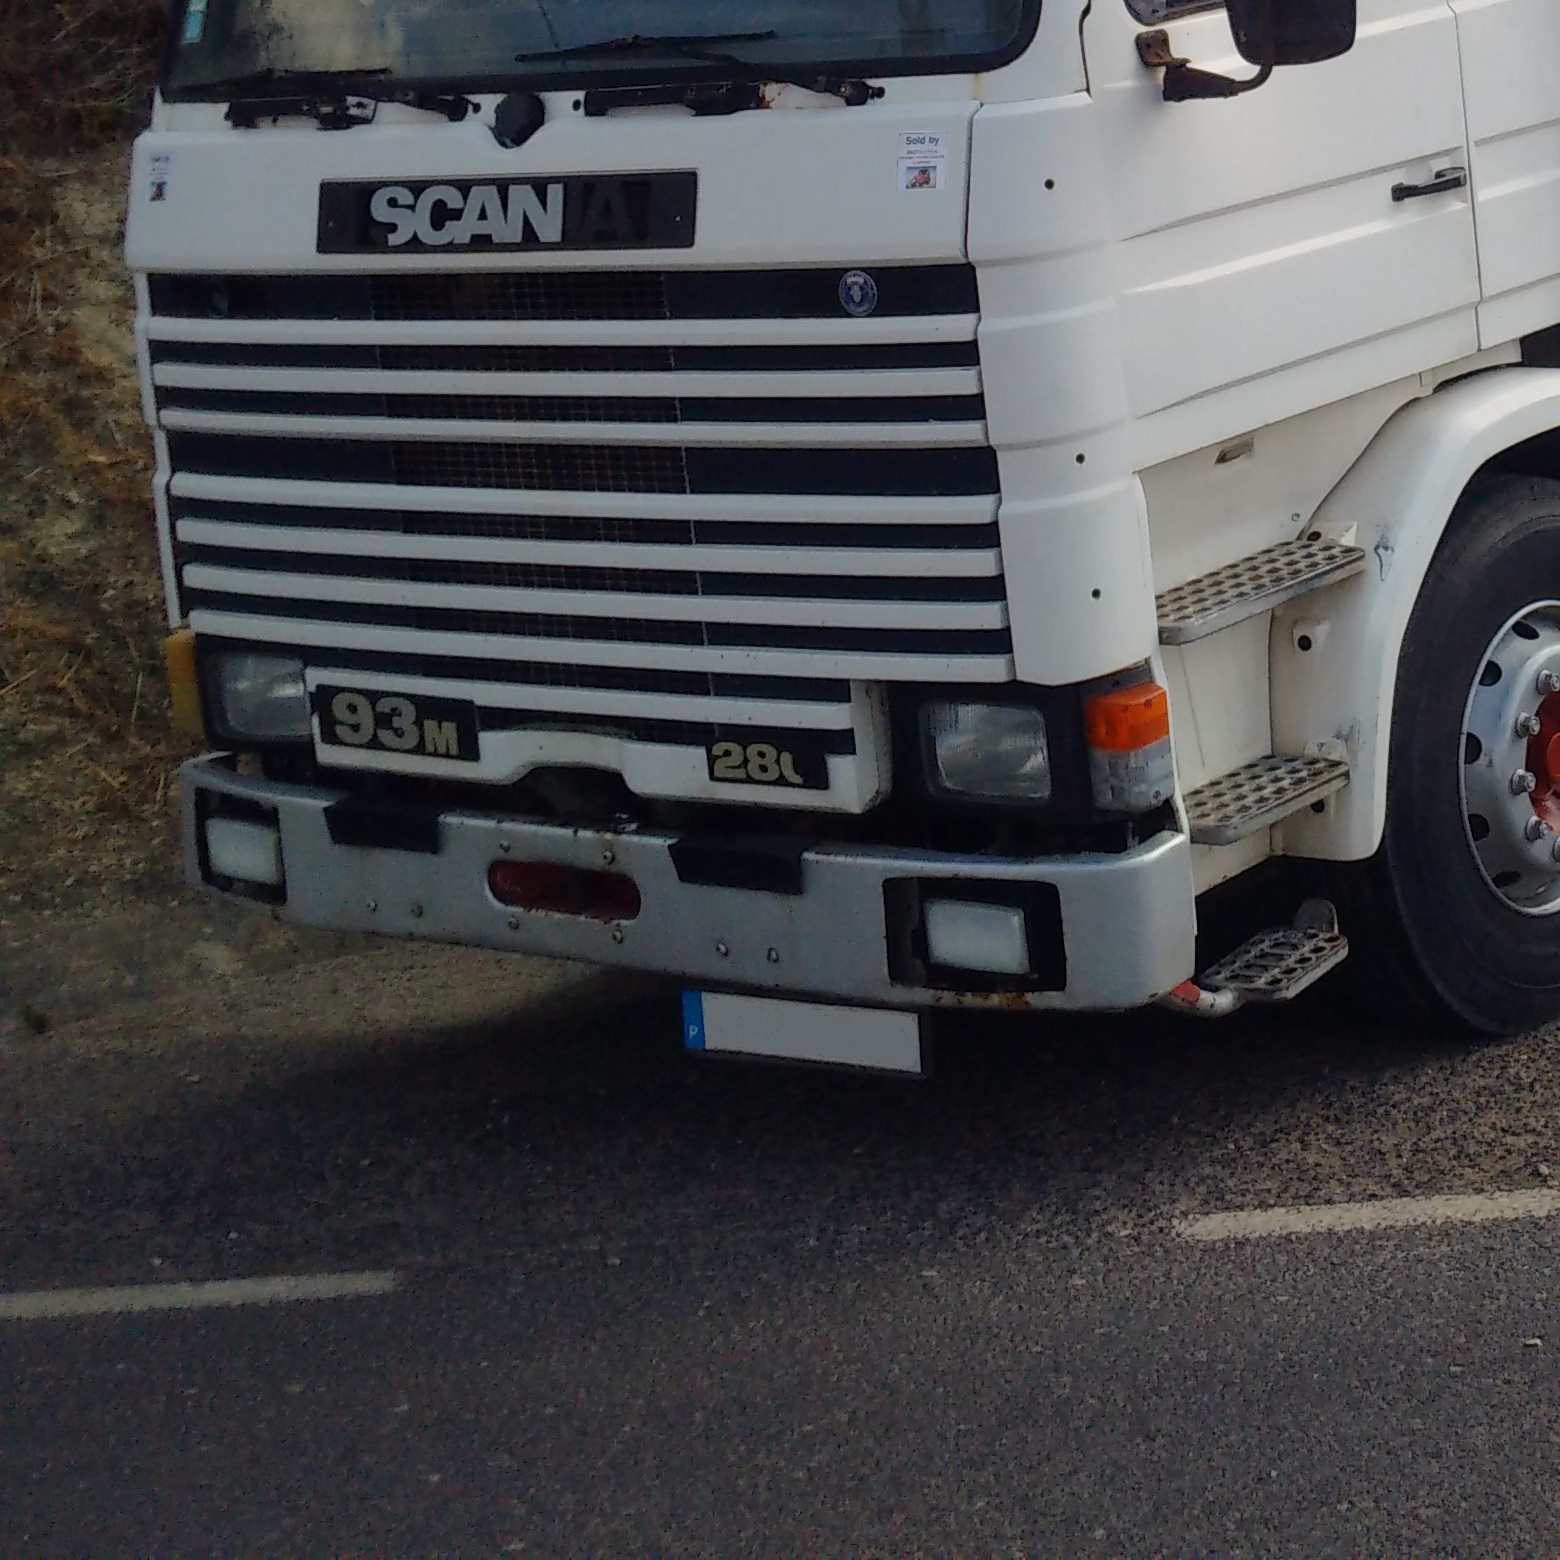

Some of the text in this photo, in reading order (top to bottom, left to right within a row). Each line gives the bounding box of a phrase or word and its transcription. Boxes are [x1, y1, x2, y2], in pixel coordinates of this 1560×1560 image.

[905, 136, 940, 147] Sold by
[688, 1024, 699, 1039] P
